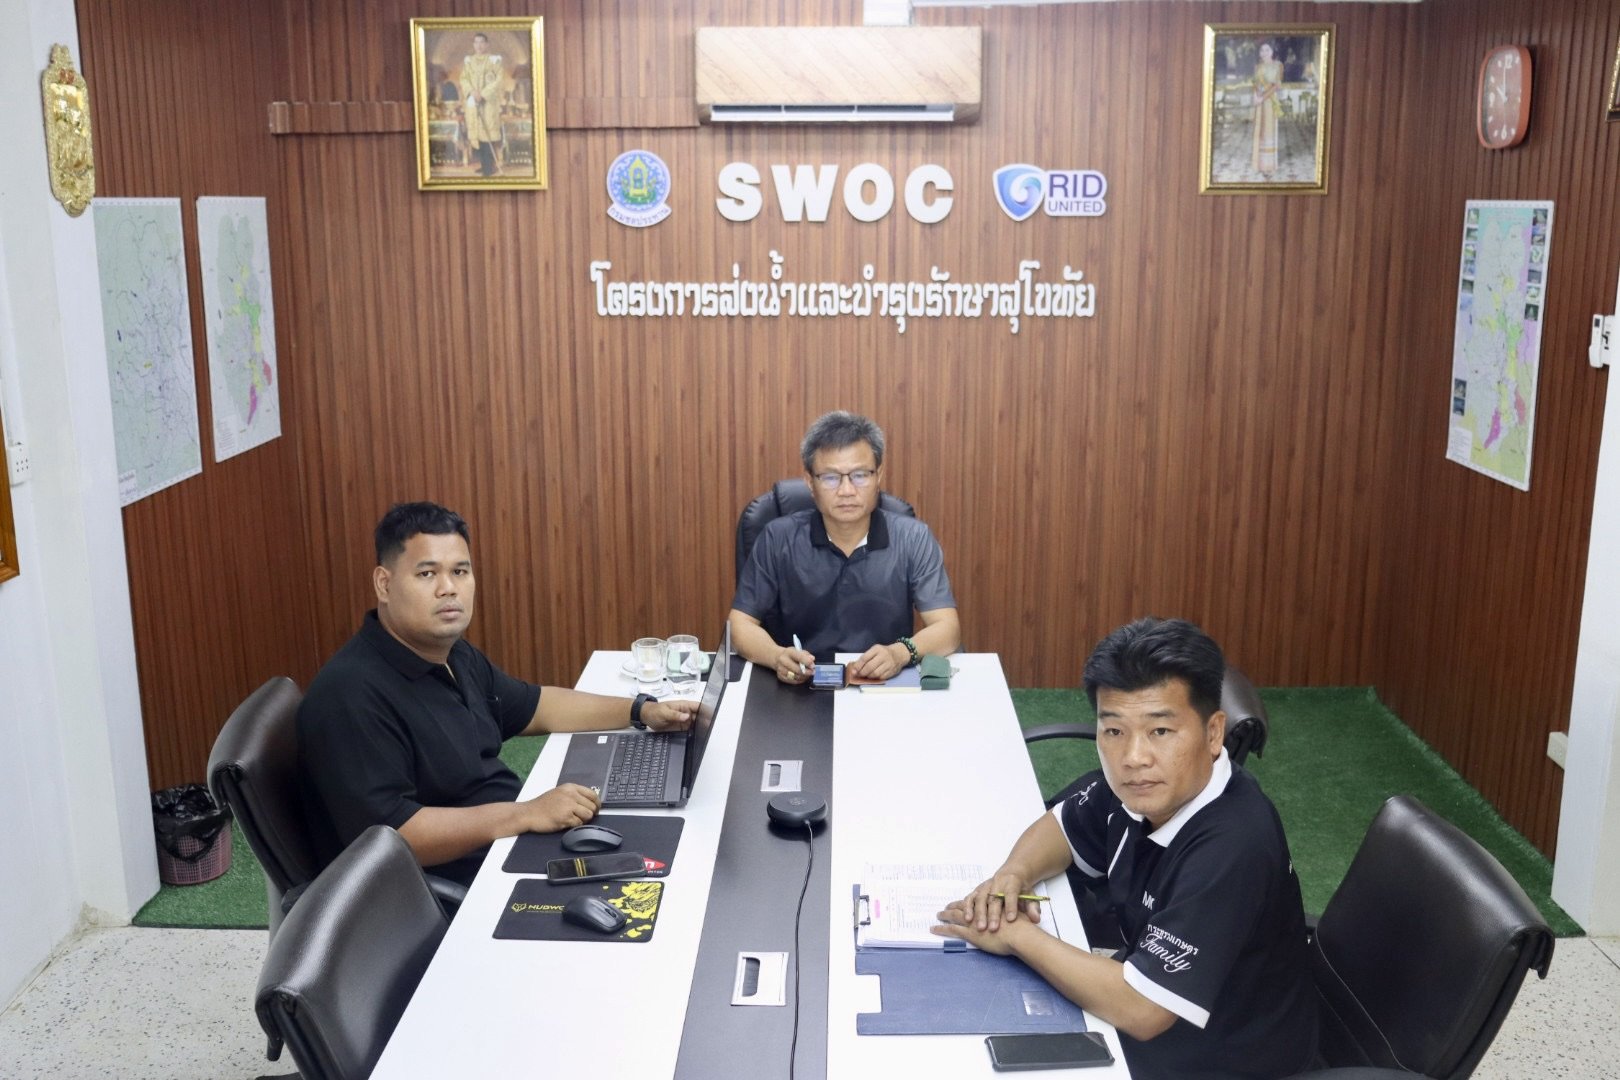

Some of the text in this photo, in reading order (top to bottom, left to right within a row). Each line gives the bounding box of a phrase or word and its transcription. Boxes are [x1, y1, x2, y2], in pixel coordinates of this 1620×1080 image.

[716, 162, 954, 224] SWOC
[1049, 174, 1103, 198] RID
[1048, 201, 1103, 213] UNITED
[590, 250, 1096, 334] โครงการส่งน้ำและบำรุงรักษาสุโขทัย
[1140, 933, 1192, 973] Family
